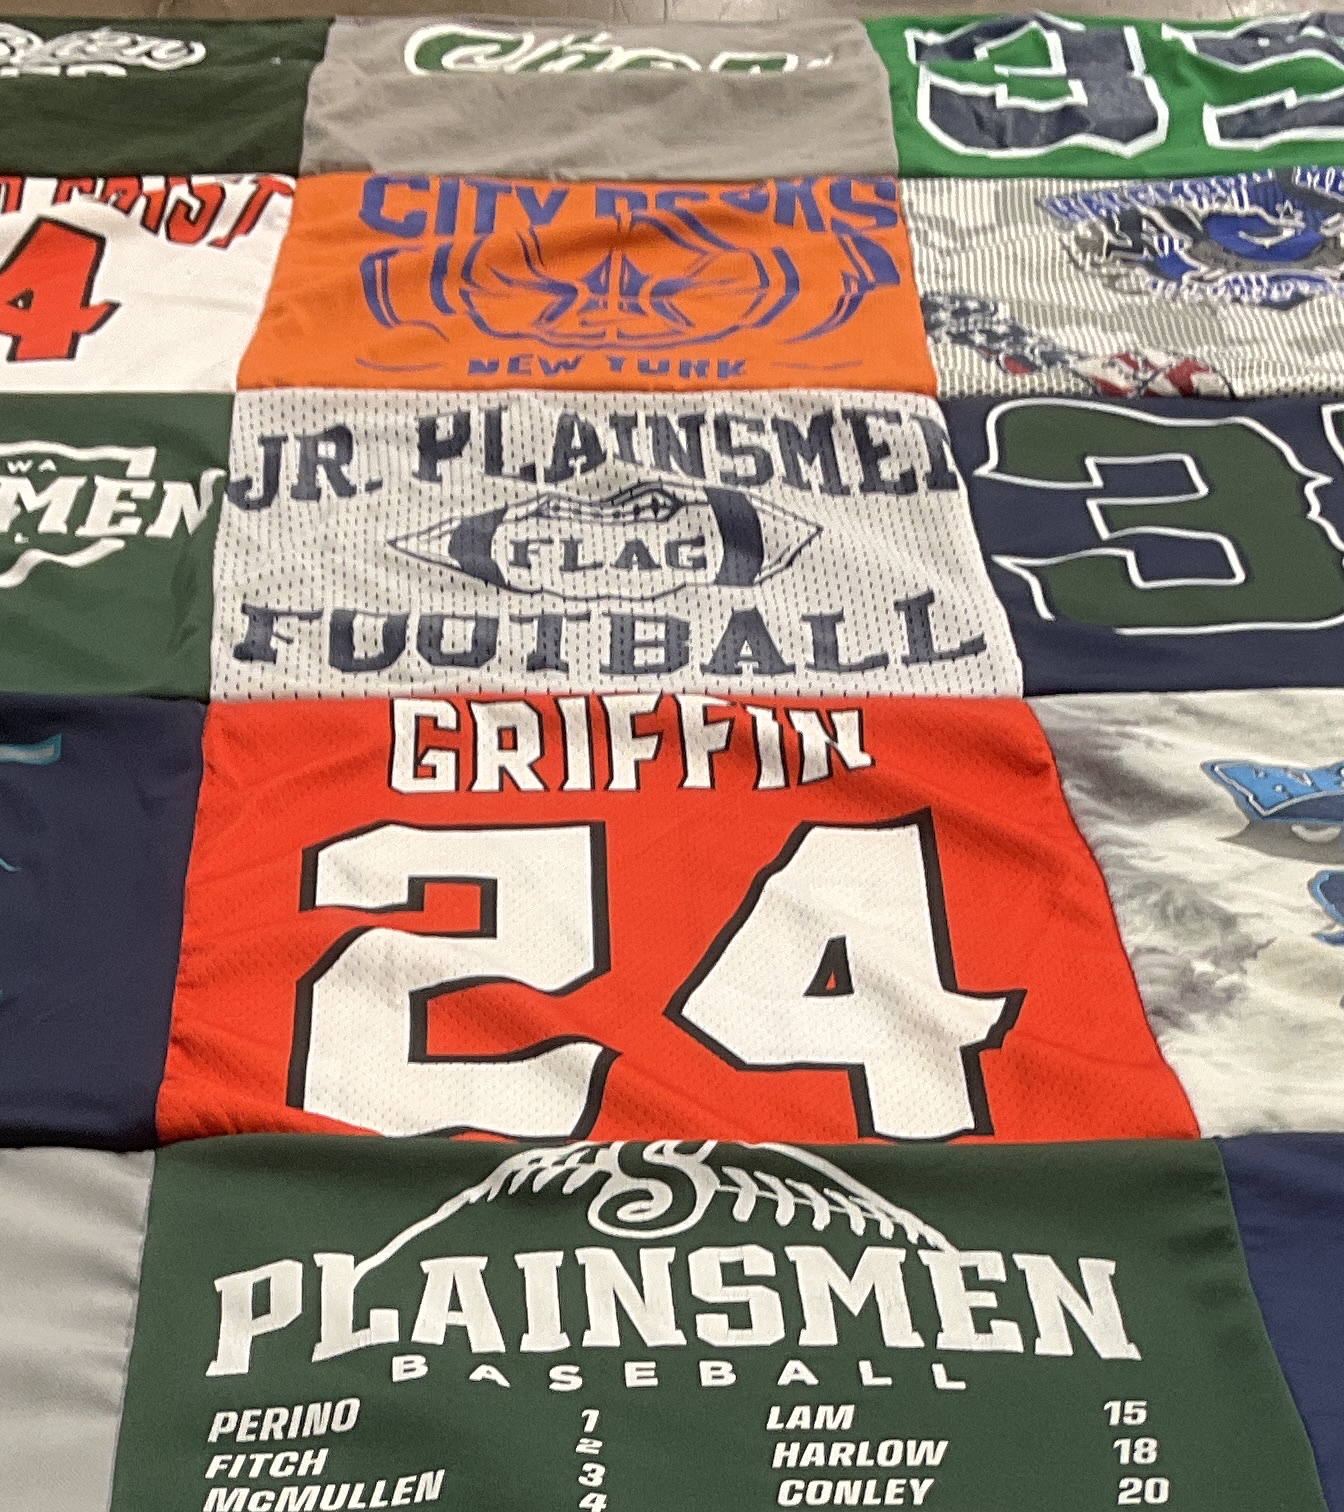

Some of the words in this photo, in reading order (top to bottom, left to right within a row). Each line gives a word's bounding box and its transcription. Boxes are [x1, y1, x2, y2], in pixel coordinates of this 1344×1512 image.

[359, 174, 569, 238] CITY
[467, 354, 585, 379] NEW
[608, 354, 750, 380] YORK
[226, 422, 384, 512] JR.
[508, 534, 706, 571] FLAG
[233, 589, 988, 677] FOOTBALL
[388, 692, 877, 794] GRIFFIN
[283, 806, 1029, 1142] 24
[205, 1245, 1143, 1377] PLAINSMEN
[391, 1353, 967, 1392] BASEBALL
[207, 1398, 360, 1442] PERINO
[581, 1409, 599, 1432] 1
[766, 1404, 855, 1430] LAM
[1103, 1400, 1148, 1427] 15
[204, 1448, 328, 1479] FITCH
[575, 1438, 603, 1454] 2
[772, 1440, 949, 1468] HARLOW
[1113, 1437, 1158, 1465] 18
[578, 1462, 605, 1487] 3
[777, 1478, 934, 1506] CONLEY
[1117, 1477, 1170, 1505] 20
[579, 1492, 607, 1512] 4
